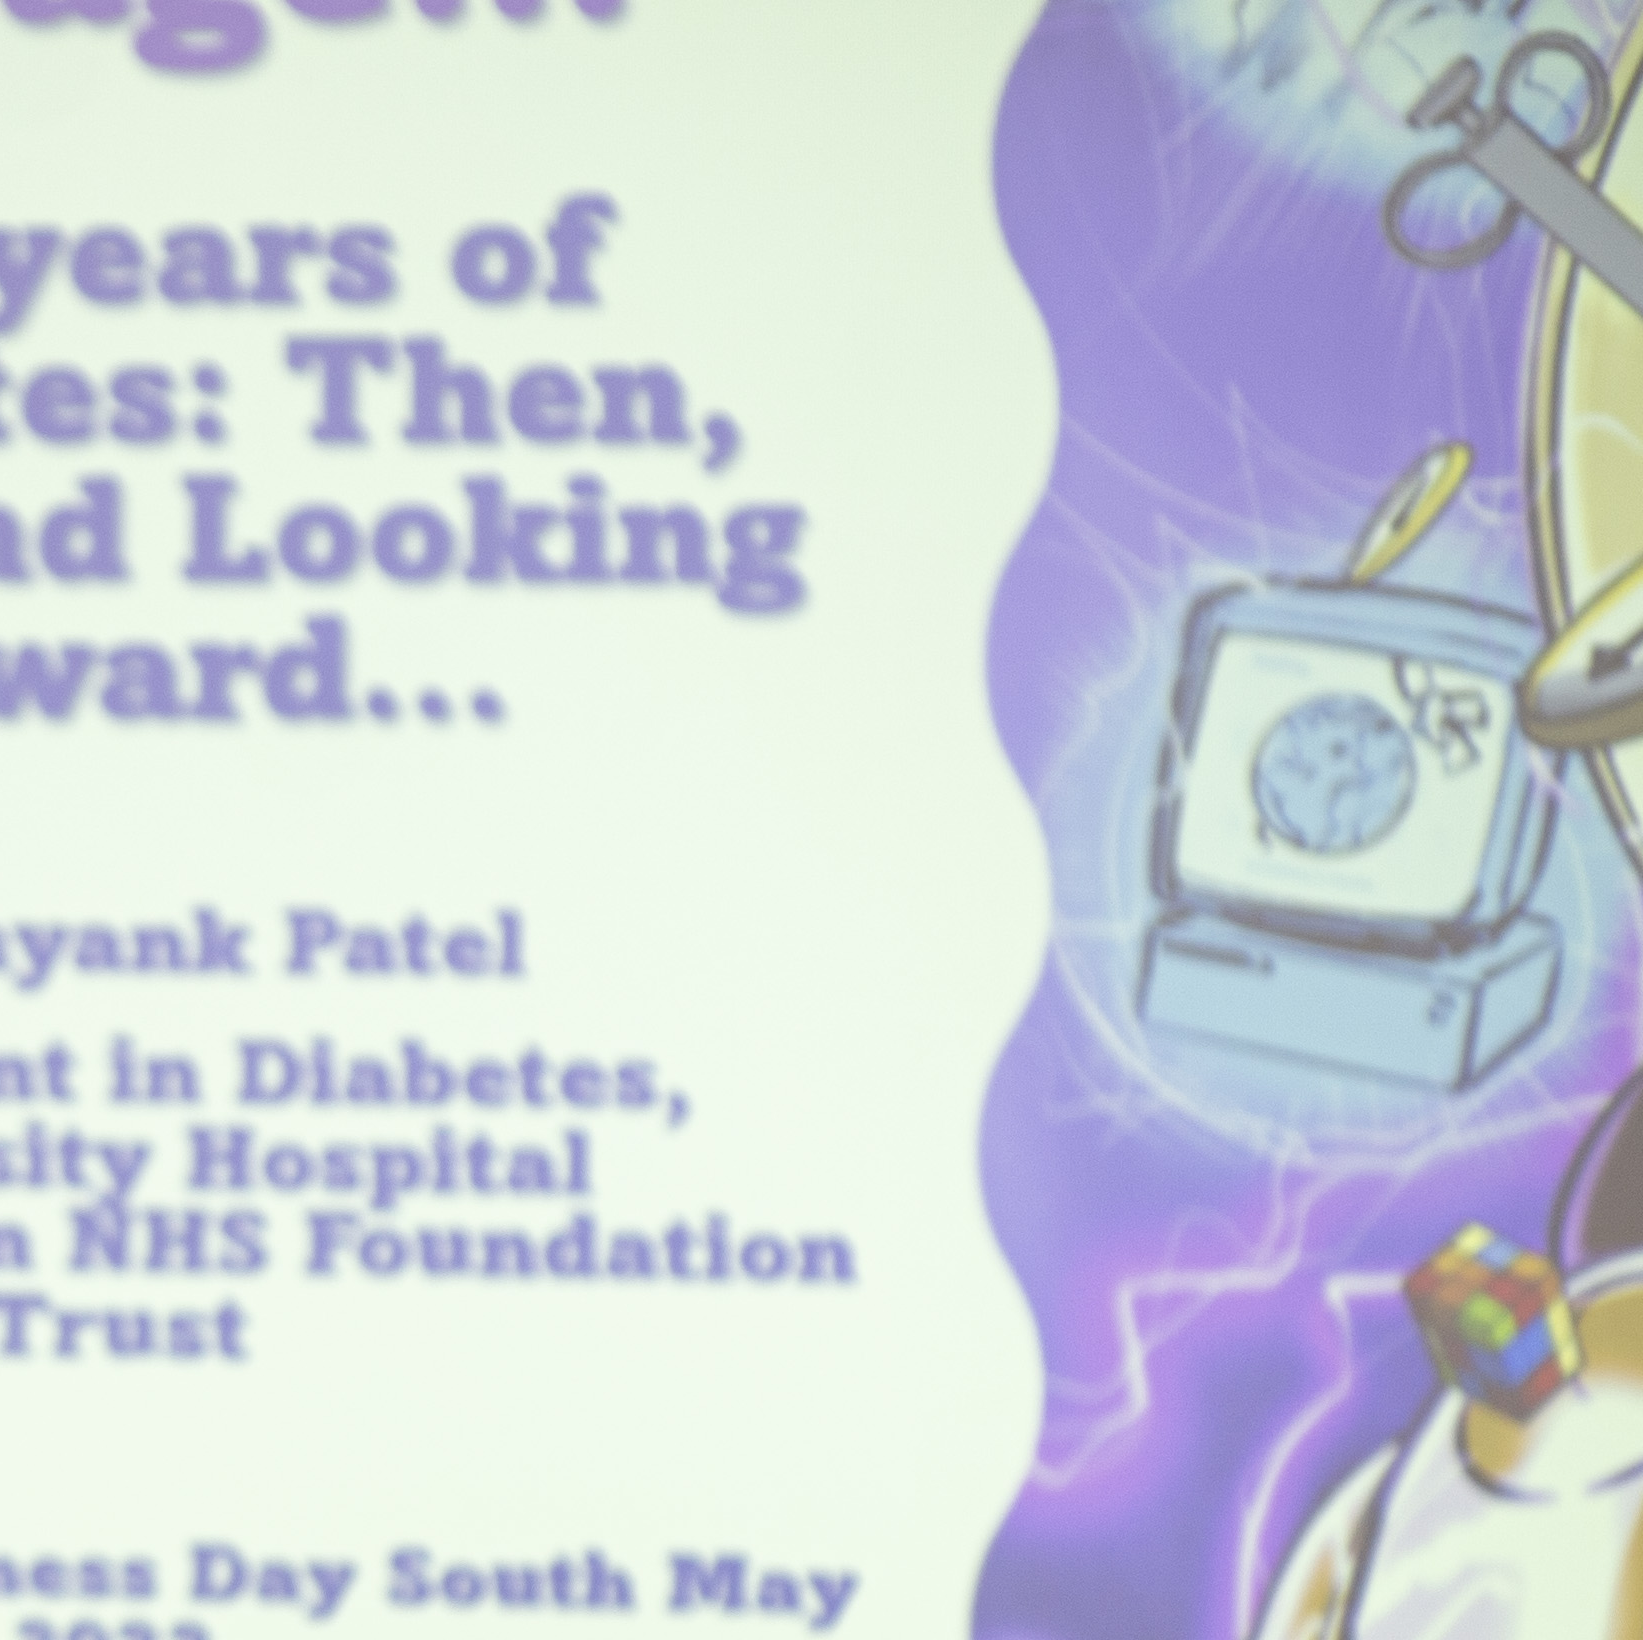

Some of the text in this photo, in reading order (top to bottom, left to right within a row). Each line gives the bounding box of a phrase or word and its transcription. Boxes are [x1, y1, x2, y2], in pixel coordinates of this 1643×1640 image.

[449, 192, 618, 308] of
[283, 334, 742, 474] Then,
[181, 471, 807, 615] Looking
[287, 909, 523, 976] Patel
[111, 1037, 200, 1103] in
[236, 1038, 688, 1129] Diabetes,
[188, 1126, 590, 1203] Hospital
[70, 1208, 267, 1274] NHS
[307, 1208, 855, 1283] Foundation
[191, 1544, 355, 1620] Day
[388, 1548, 635, 1611] South
[669, 1553, 857, 1631] May
